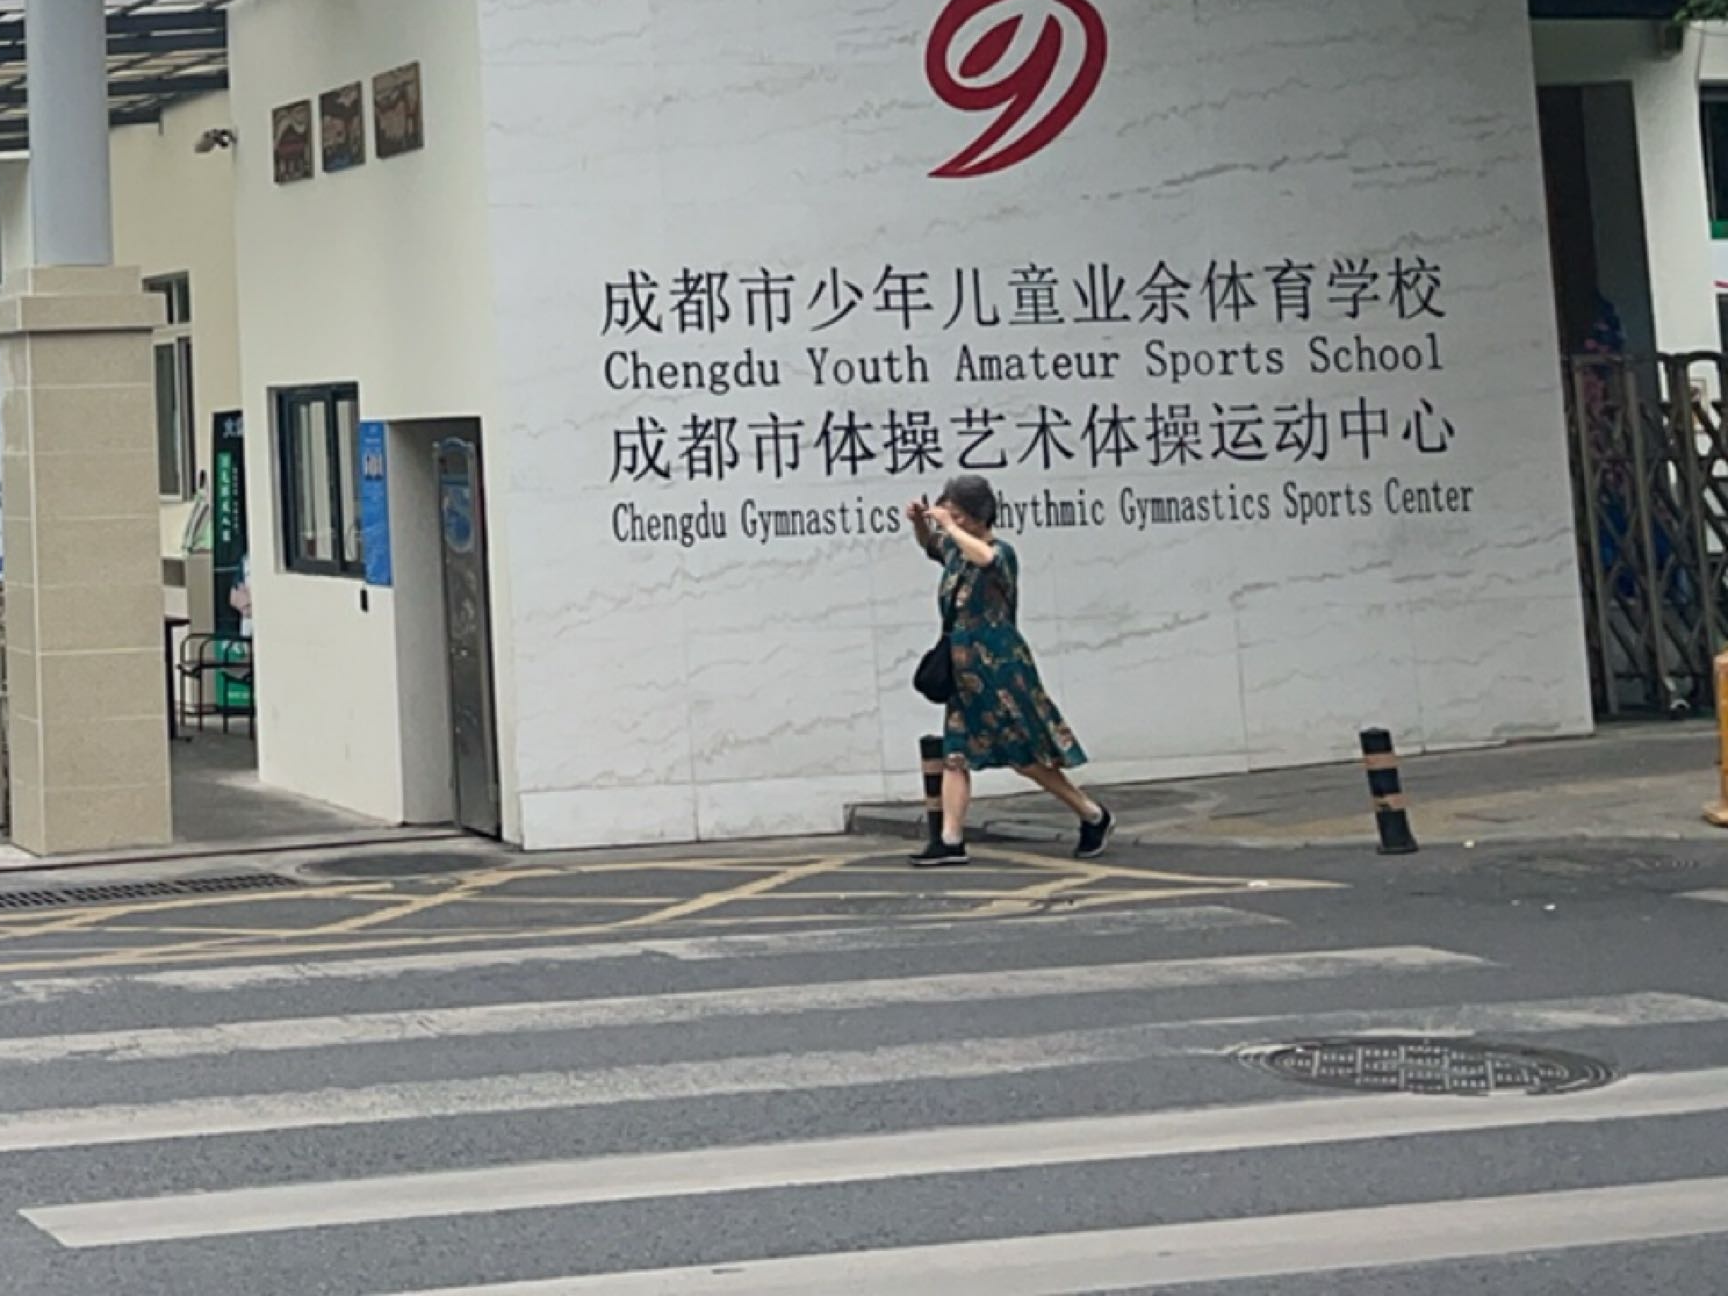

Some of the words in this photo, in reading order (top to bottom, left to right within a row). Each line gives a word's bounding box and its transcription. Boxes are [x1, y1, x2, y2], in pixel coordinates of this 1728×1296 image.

[601, 256, 1447, 336] 成都市少年儿童业余体育学校
[604, 349, 780, 395] Chengdu
[806, 344, 929, 385] Youth
[955, 344, 1120, 382] Amateur
[1145, 339, 1284, 379] Sports
[1308, 334, 1444, 372] School
[609, 397, 1456, 484] 成都市体操艺术体操运动中心
[612, 499, 727, 546] Chengdu
[740, 495, 901, 543] Gymnastics
[993, 488, 1105, 534] hythmic
[1120, 483, 1270, 531] Gymnastics
[1283, 481, 1373, 522] Sports
[1385, 476, 1474, 514] Center
